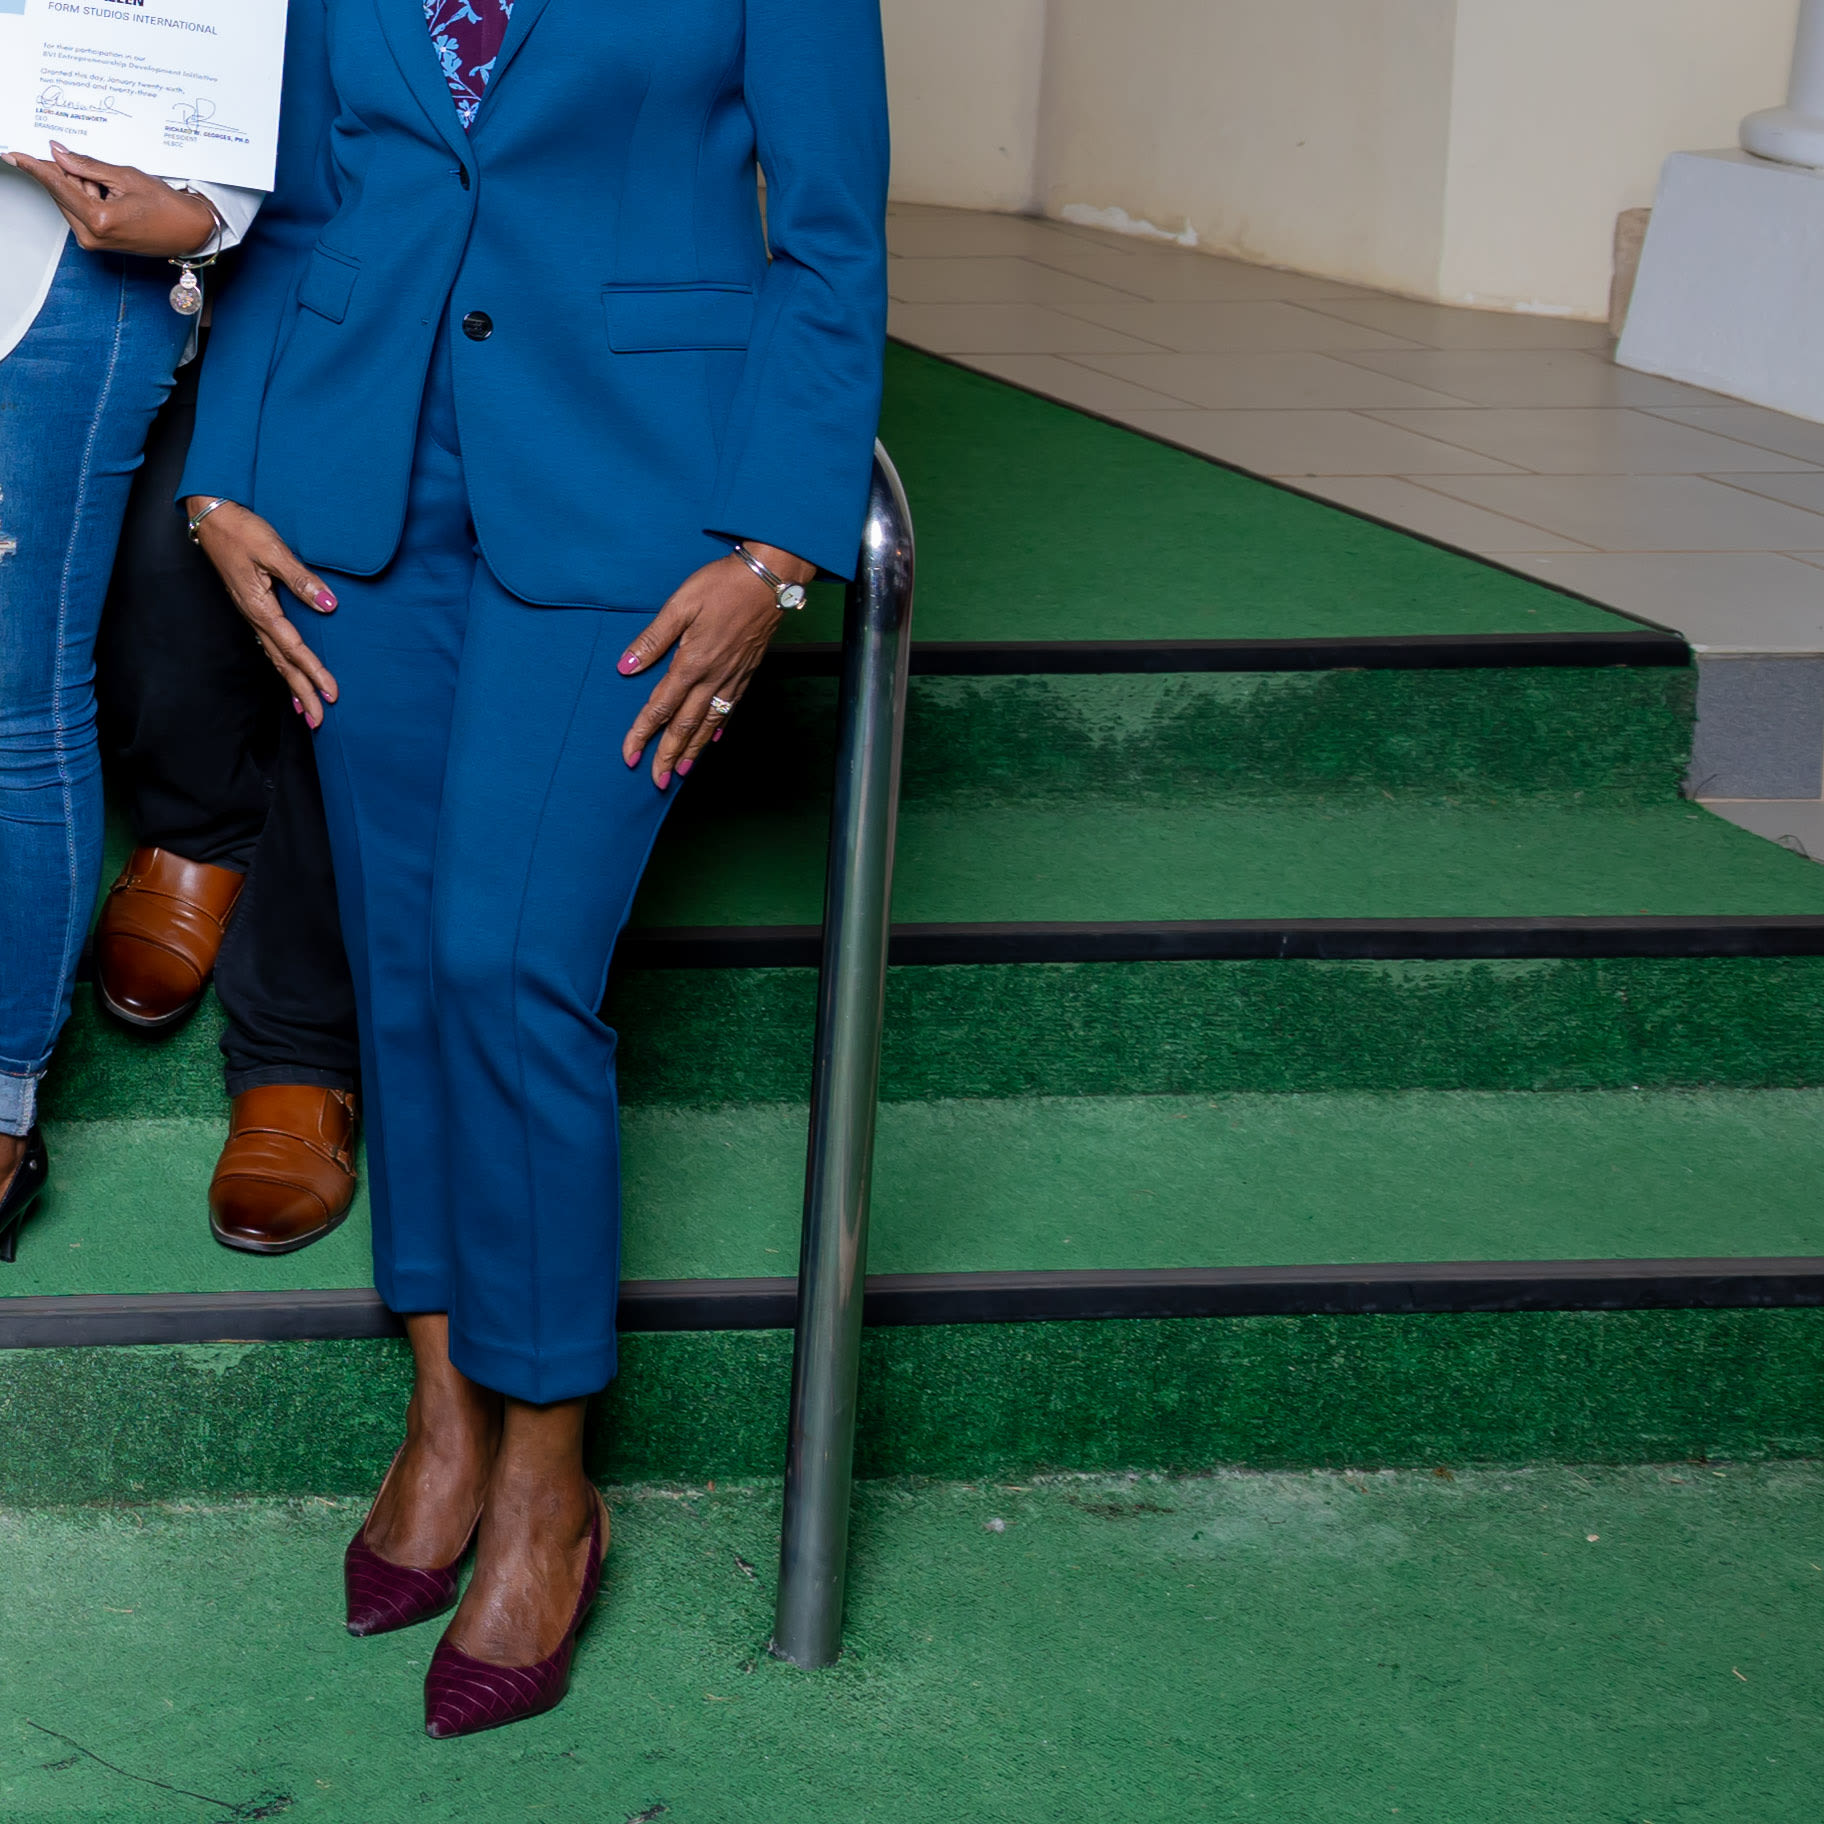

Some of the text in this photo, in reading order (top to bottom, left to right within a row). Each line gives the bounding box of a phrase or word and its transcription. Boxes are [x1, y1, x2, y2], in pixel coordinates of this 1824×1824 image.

[49, 1, 218, 35] FORM STUDIOS INTERNATIONAL
